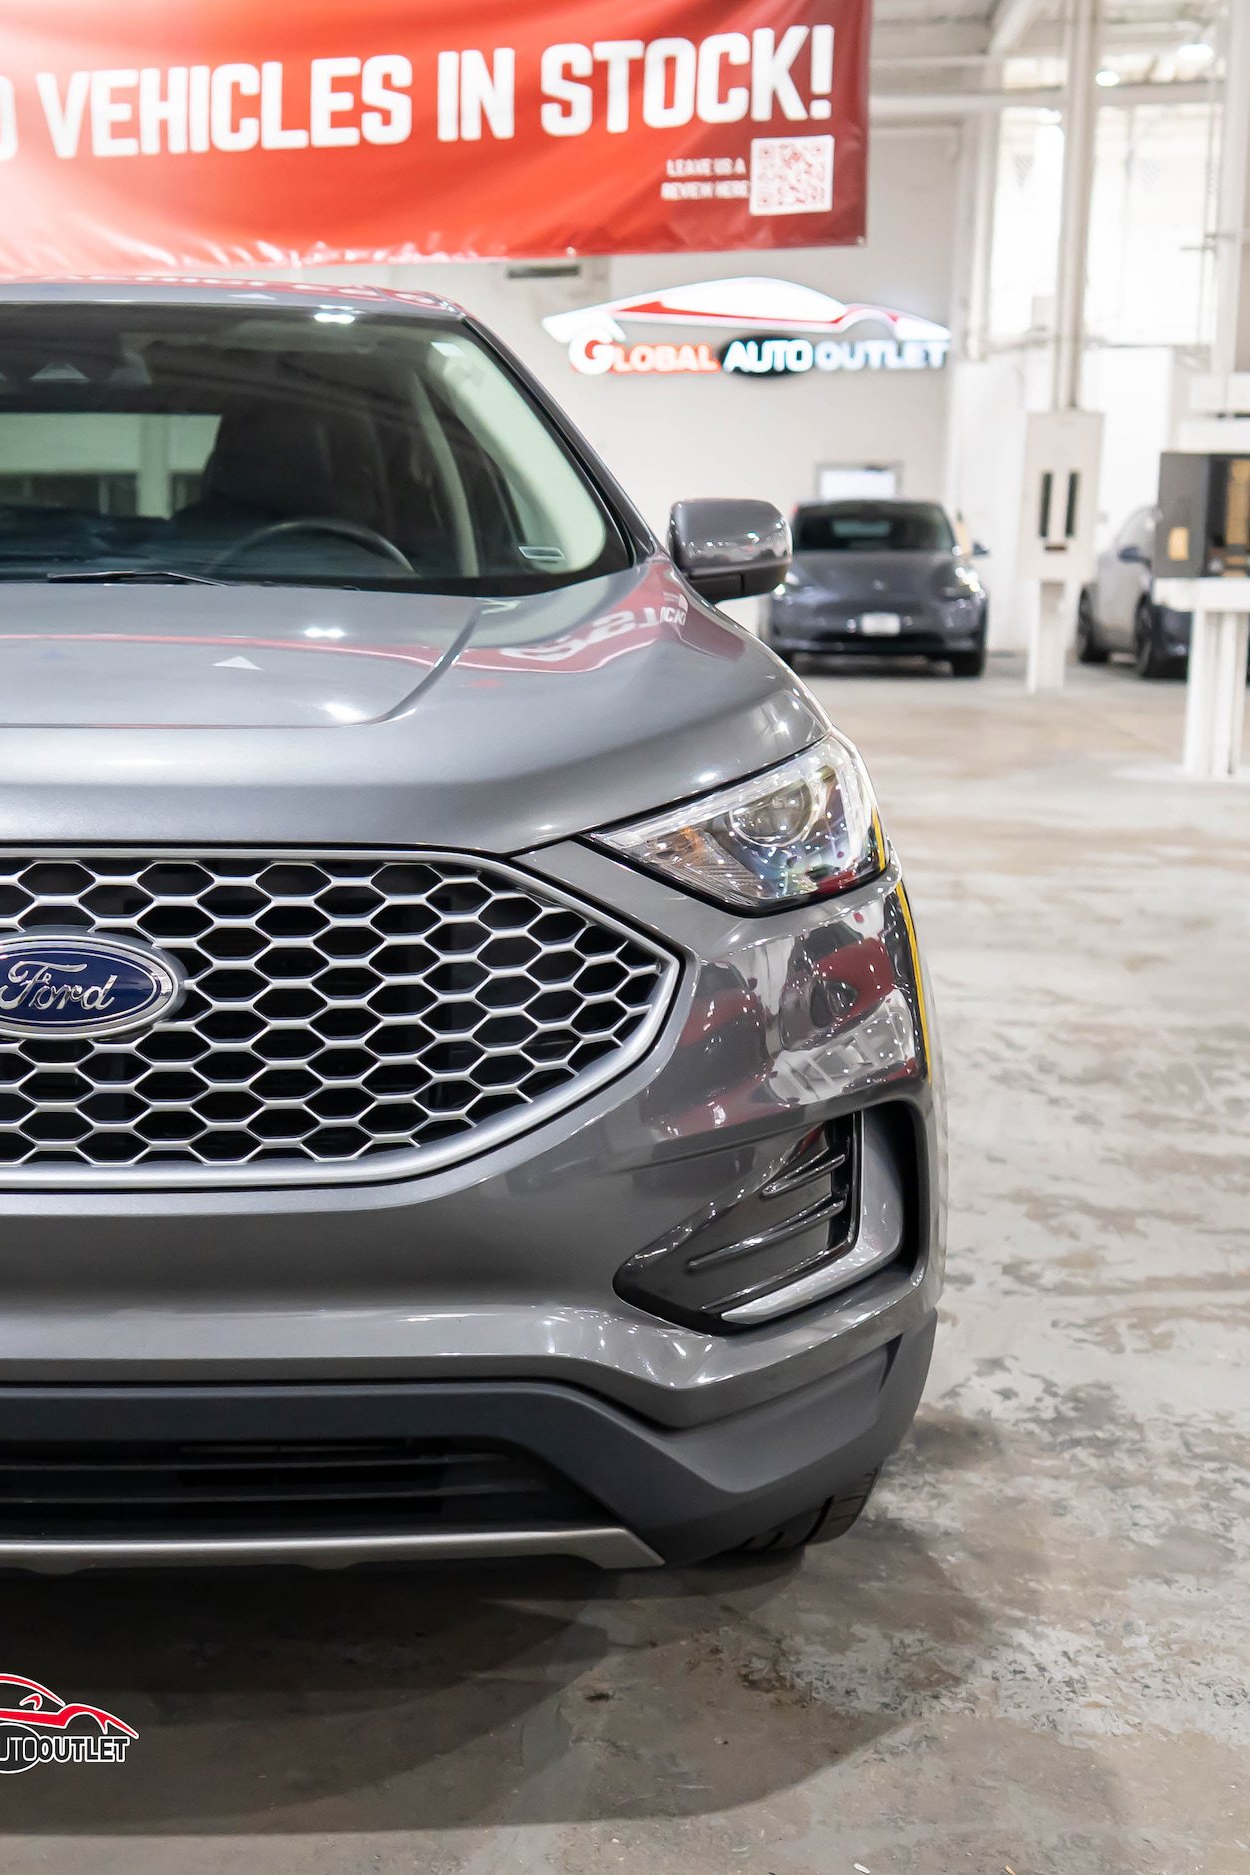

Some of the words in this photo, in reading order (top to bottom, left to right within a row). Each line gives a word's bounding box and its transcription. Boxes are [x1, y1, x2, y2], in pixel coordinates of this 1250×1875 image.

[36, 54, 412, 159] VEHICLES
[437, 48, 515, 141] IN
[541, 24, 834, 137] STOCK!
[569, 326, 721, 375] GLOBAL
[723, 339, 814, 374] AUTO
[814, 340, 948, 370] OUTLET
